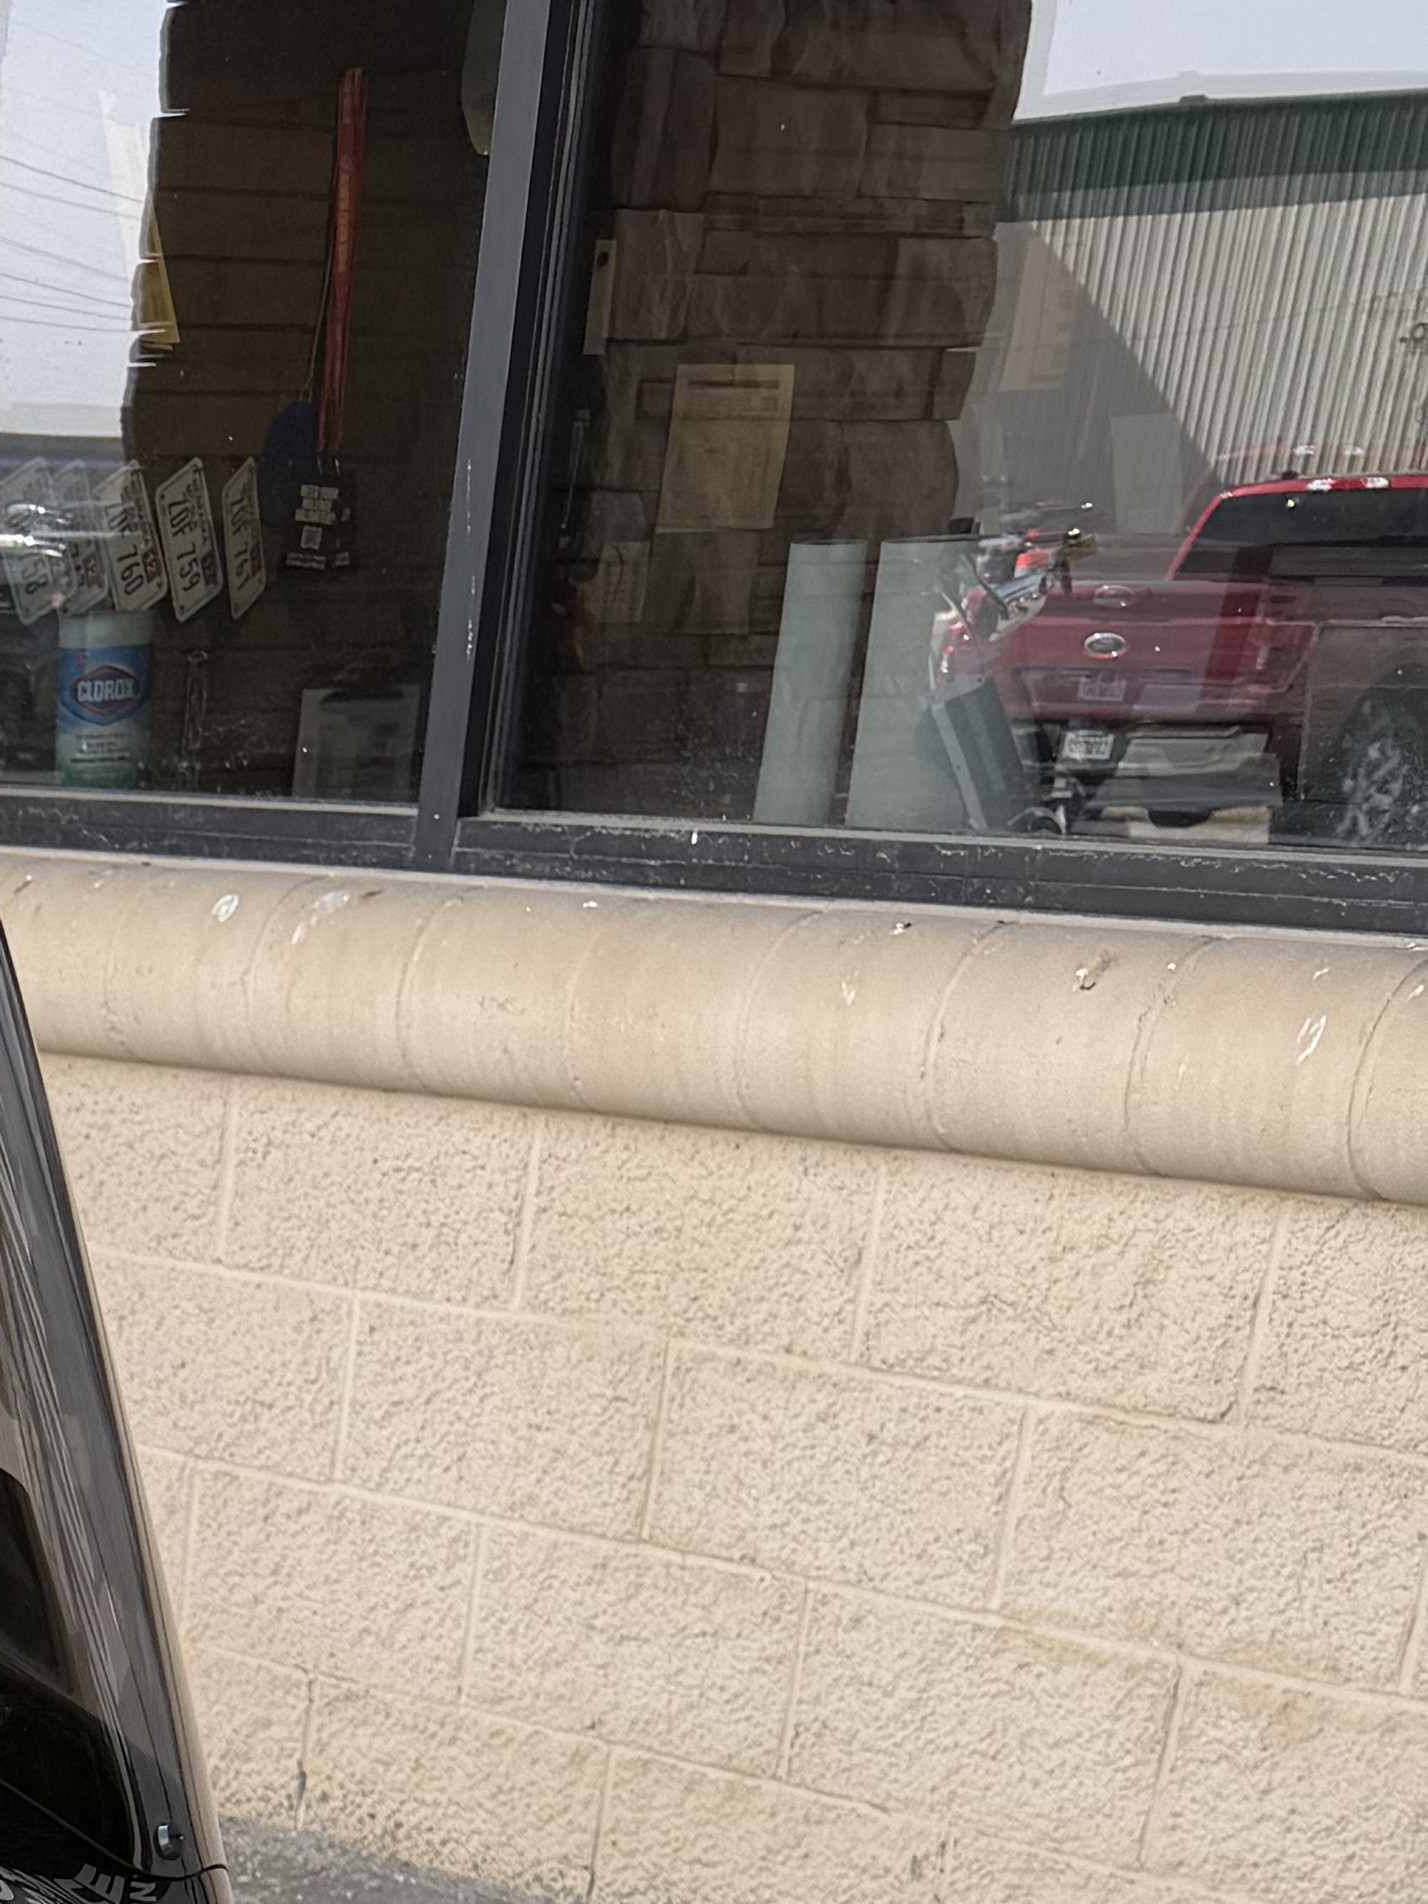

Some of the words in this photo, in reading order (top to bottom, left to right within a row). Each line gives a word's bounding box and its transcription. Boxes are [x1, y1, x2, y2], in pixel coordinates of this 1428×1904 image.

[117, 544, 144, 596] 760
[176, 543, 202, 592] 759
[76, 678, 135, 702] CLOROX
